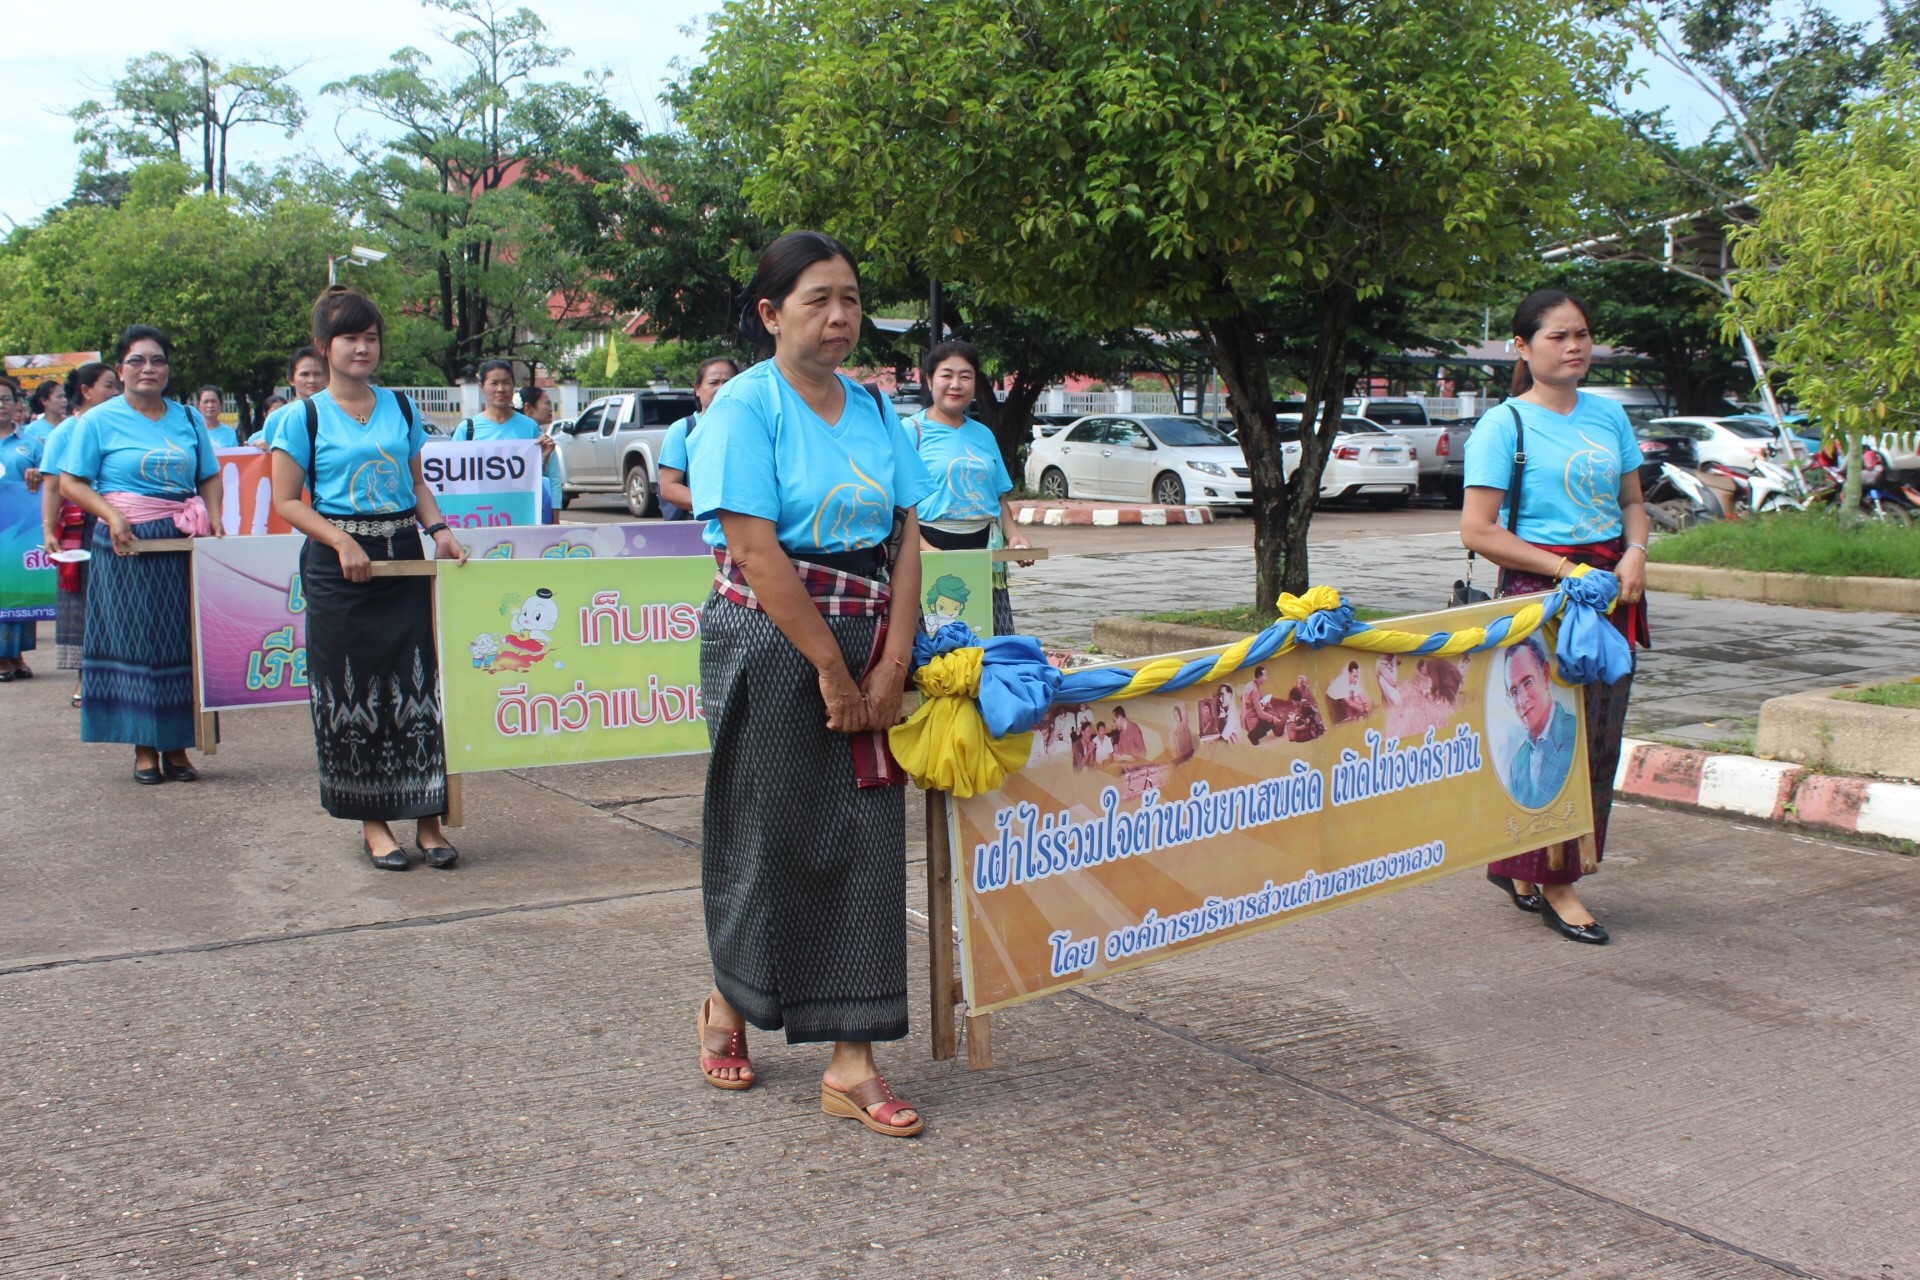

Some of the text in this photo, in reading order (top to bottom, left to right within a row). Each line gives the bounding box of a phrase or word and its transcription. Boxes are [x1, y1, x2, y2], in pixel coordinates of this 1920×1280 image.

[423, 455, 525, 492] รุนแรง
[579, 590, 702, 645] เก็บแร
[1049, 929, 1098, 976] โดย
